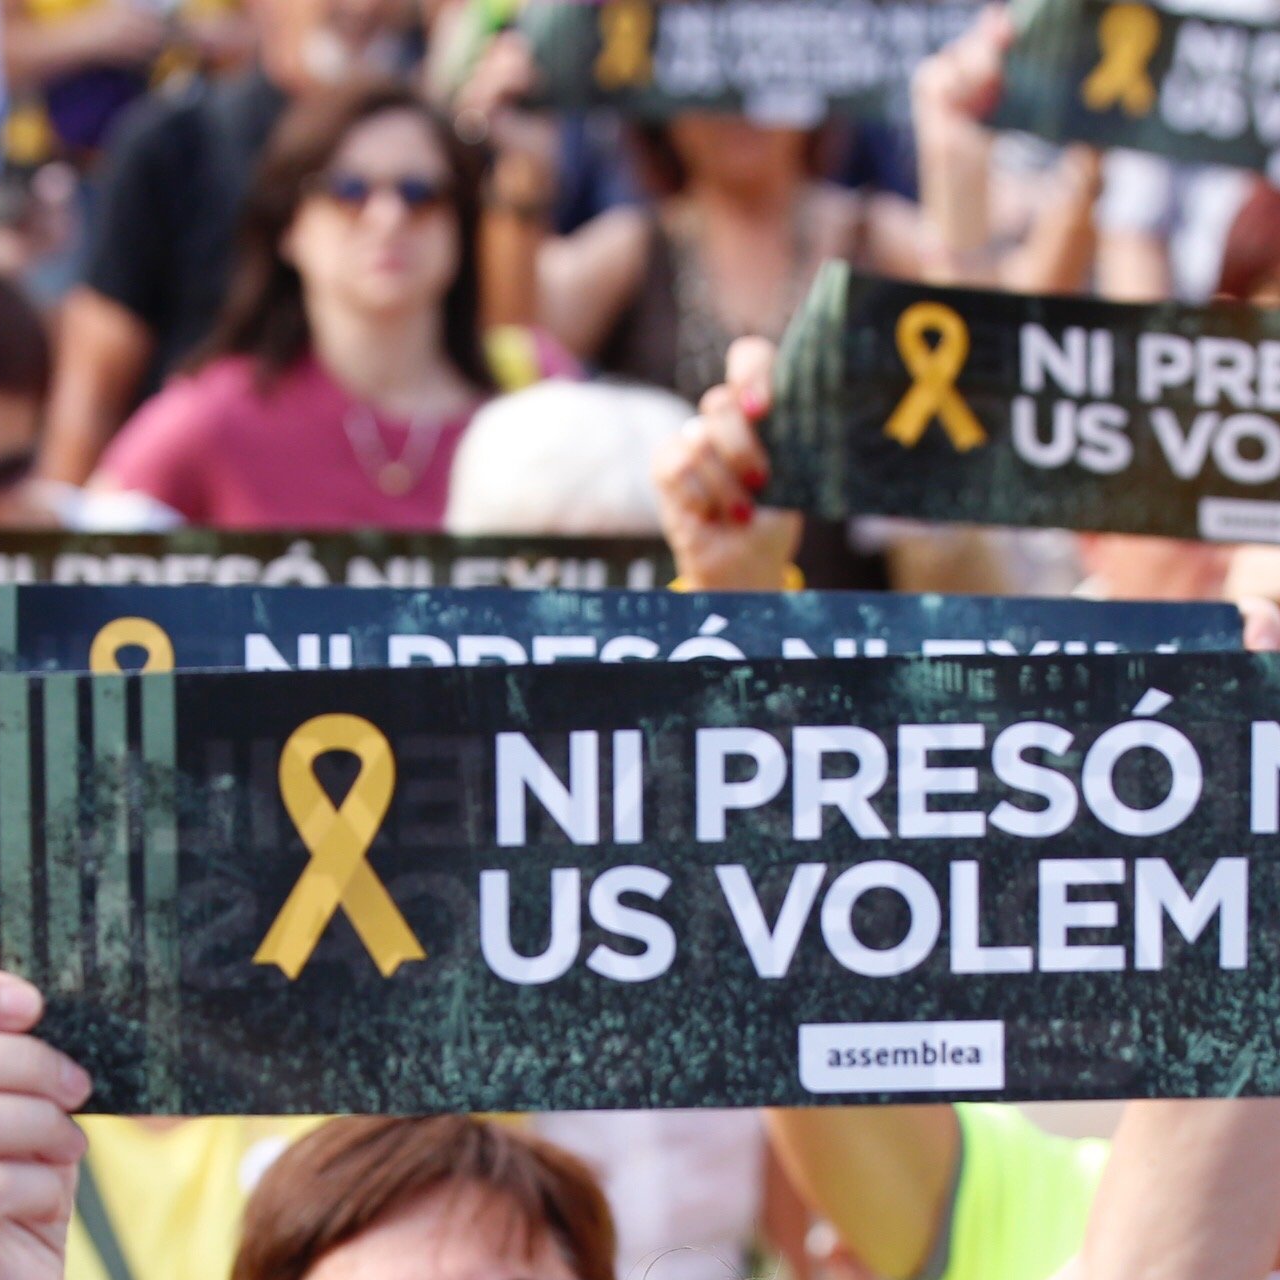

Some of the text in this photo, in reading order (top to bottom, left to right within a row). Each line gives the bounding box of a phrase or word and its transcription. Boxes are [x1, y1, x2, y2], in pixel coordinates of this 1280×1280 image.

[1021, 323, 1114, 398] NI
[1011, 396, 1133, 474] US
[495, 730, 642, 847] NI
[695, 687, 1203, 842] PRESÓ
[479, 865, 677, 985] US
[715, 857, 1249, 979] VOLEM
[827, 1040, 982, 1068] assemblea
